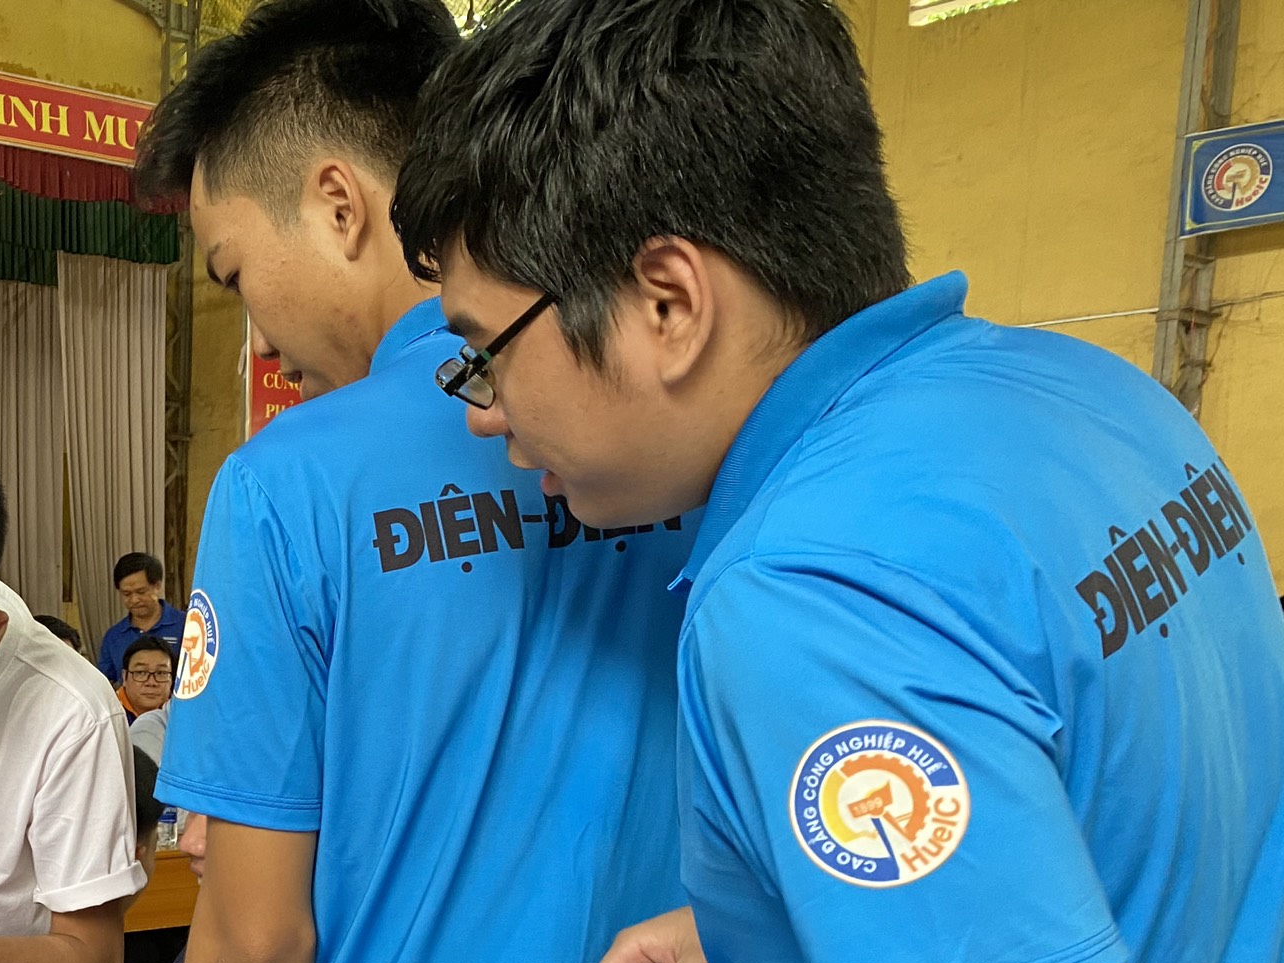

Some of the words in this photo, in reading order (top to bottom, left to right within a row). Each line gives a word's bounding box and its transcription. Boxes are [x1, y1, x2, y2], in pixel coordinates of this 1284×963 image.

[83, 110, 143, 149] MU
[835, 732, 906, 756] NGHIỆP
[803, 752, 834, 801] CÔNG
[901, 796, 962, 873] HueIC
[836, 854, 877, 873] CAO
